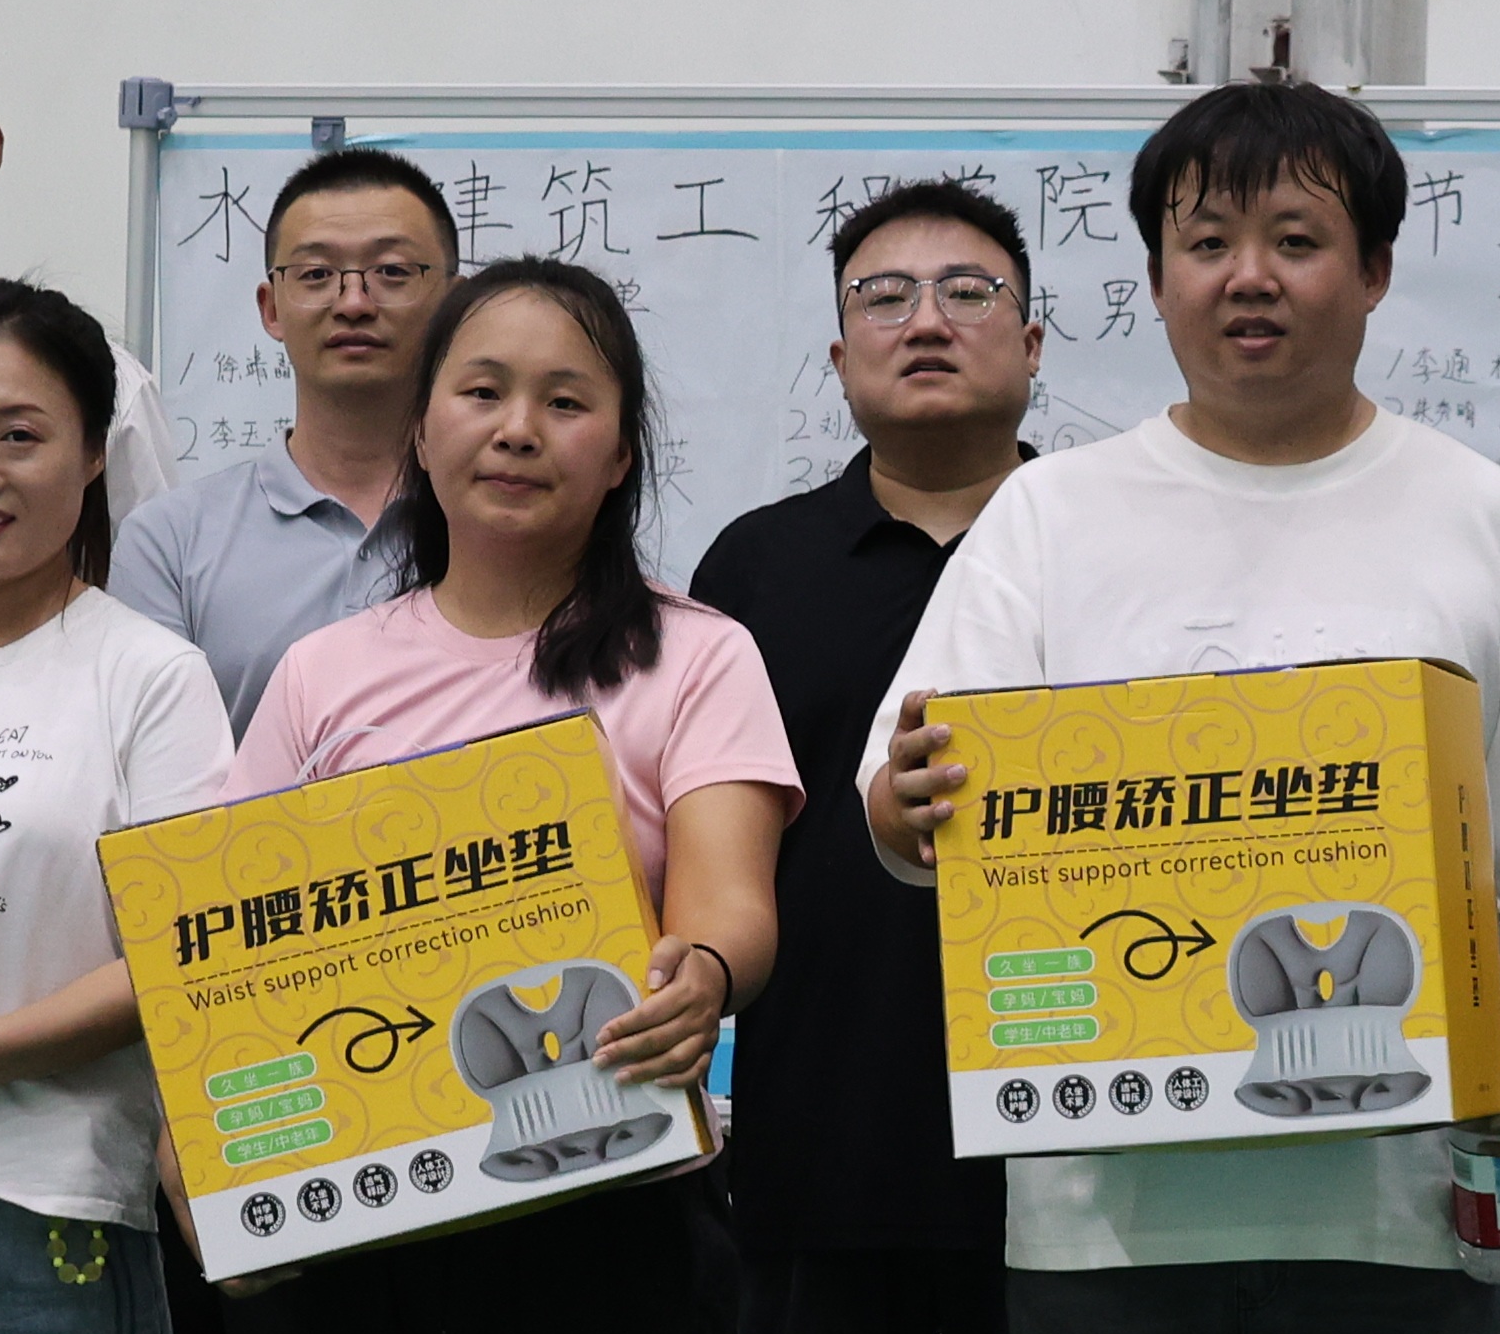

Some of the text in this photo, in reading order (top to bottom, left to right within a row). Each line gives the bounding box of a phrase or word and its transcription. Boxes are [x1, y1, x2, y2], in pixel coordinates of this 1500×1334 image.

[176, 417, 199, 462] 2
[786, 409, 810, 442] 2
[981, 762, 1381, 840] 护腰矫正坐垫
[982, 838, 1387, 889] Waist support correction cushion
[174, 821, 575, 967] 护腰矫正坐垫
[187, 897, 592, 1012] Waist support correction cushion
[1000, 954, 1082, 975] 久坐一族
[1003, 989, 1086, 1009] 孕妈/宝妈
[1004, 1023, 1087, 1043] 学生/中老年
[221, 1060, 305, 1092] 久坐一族
